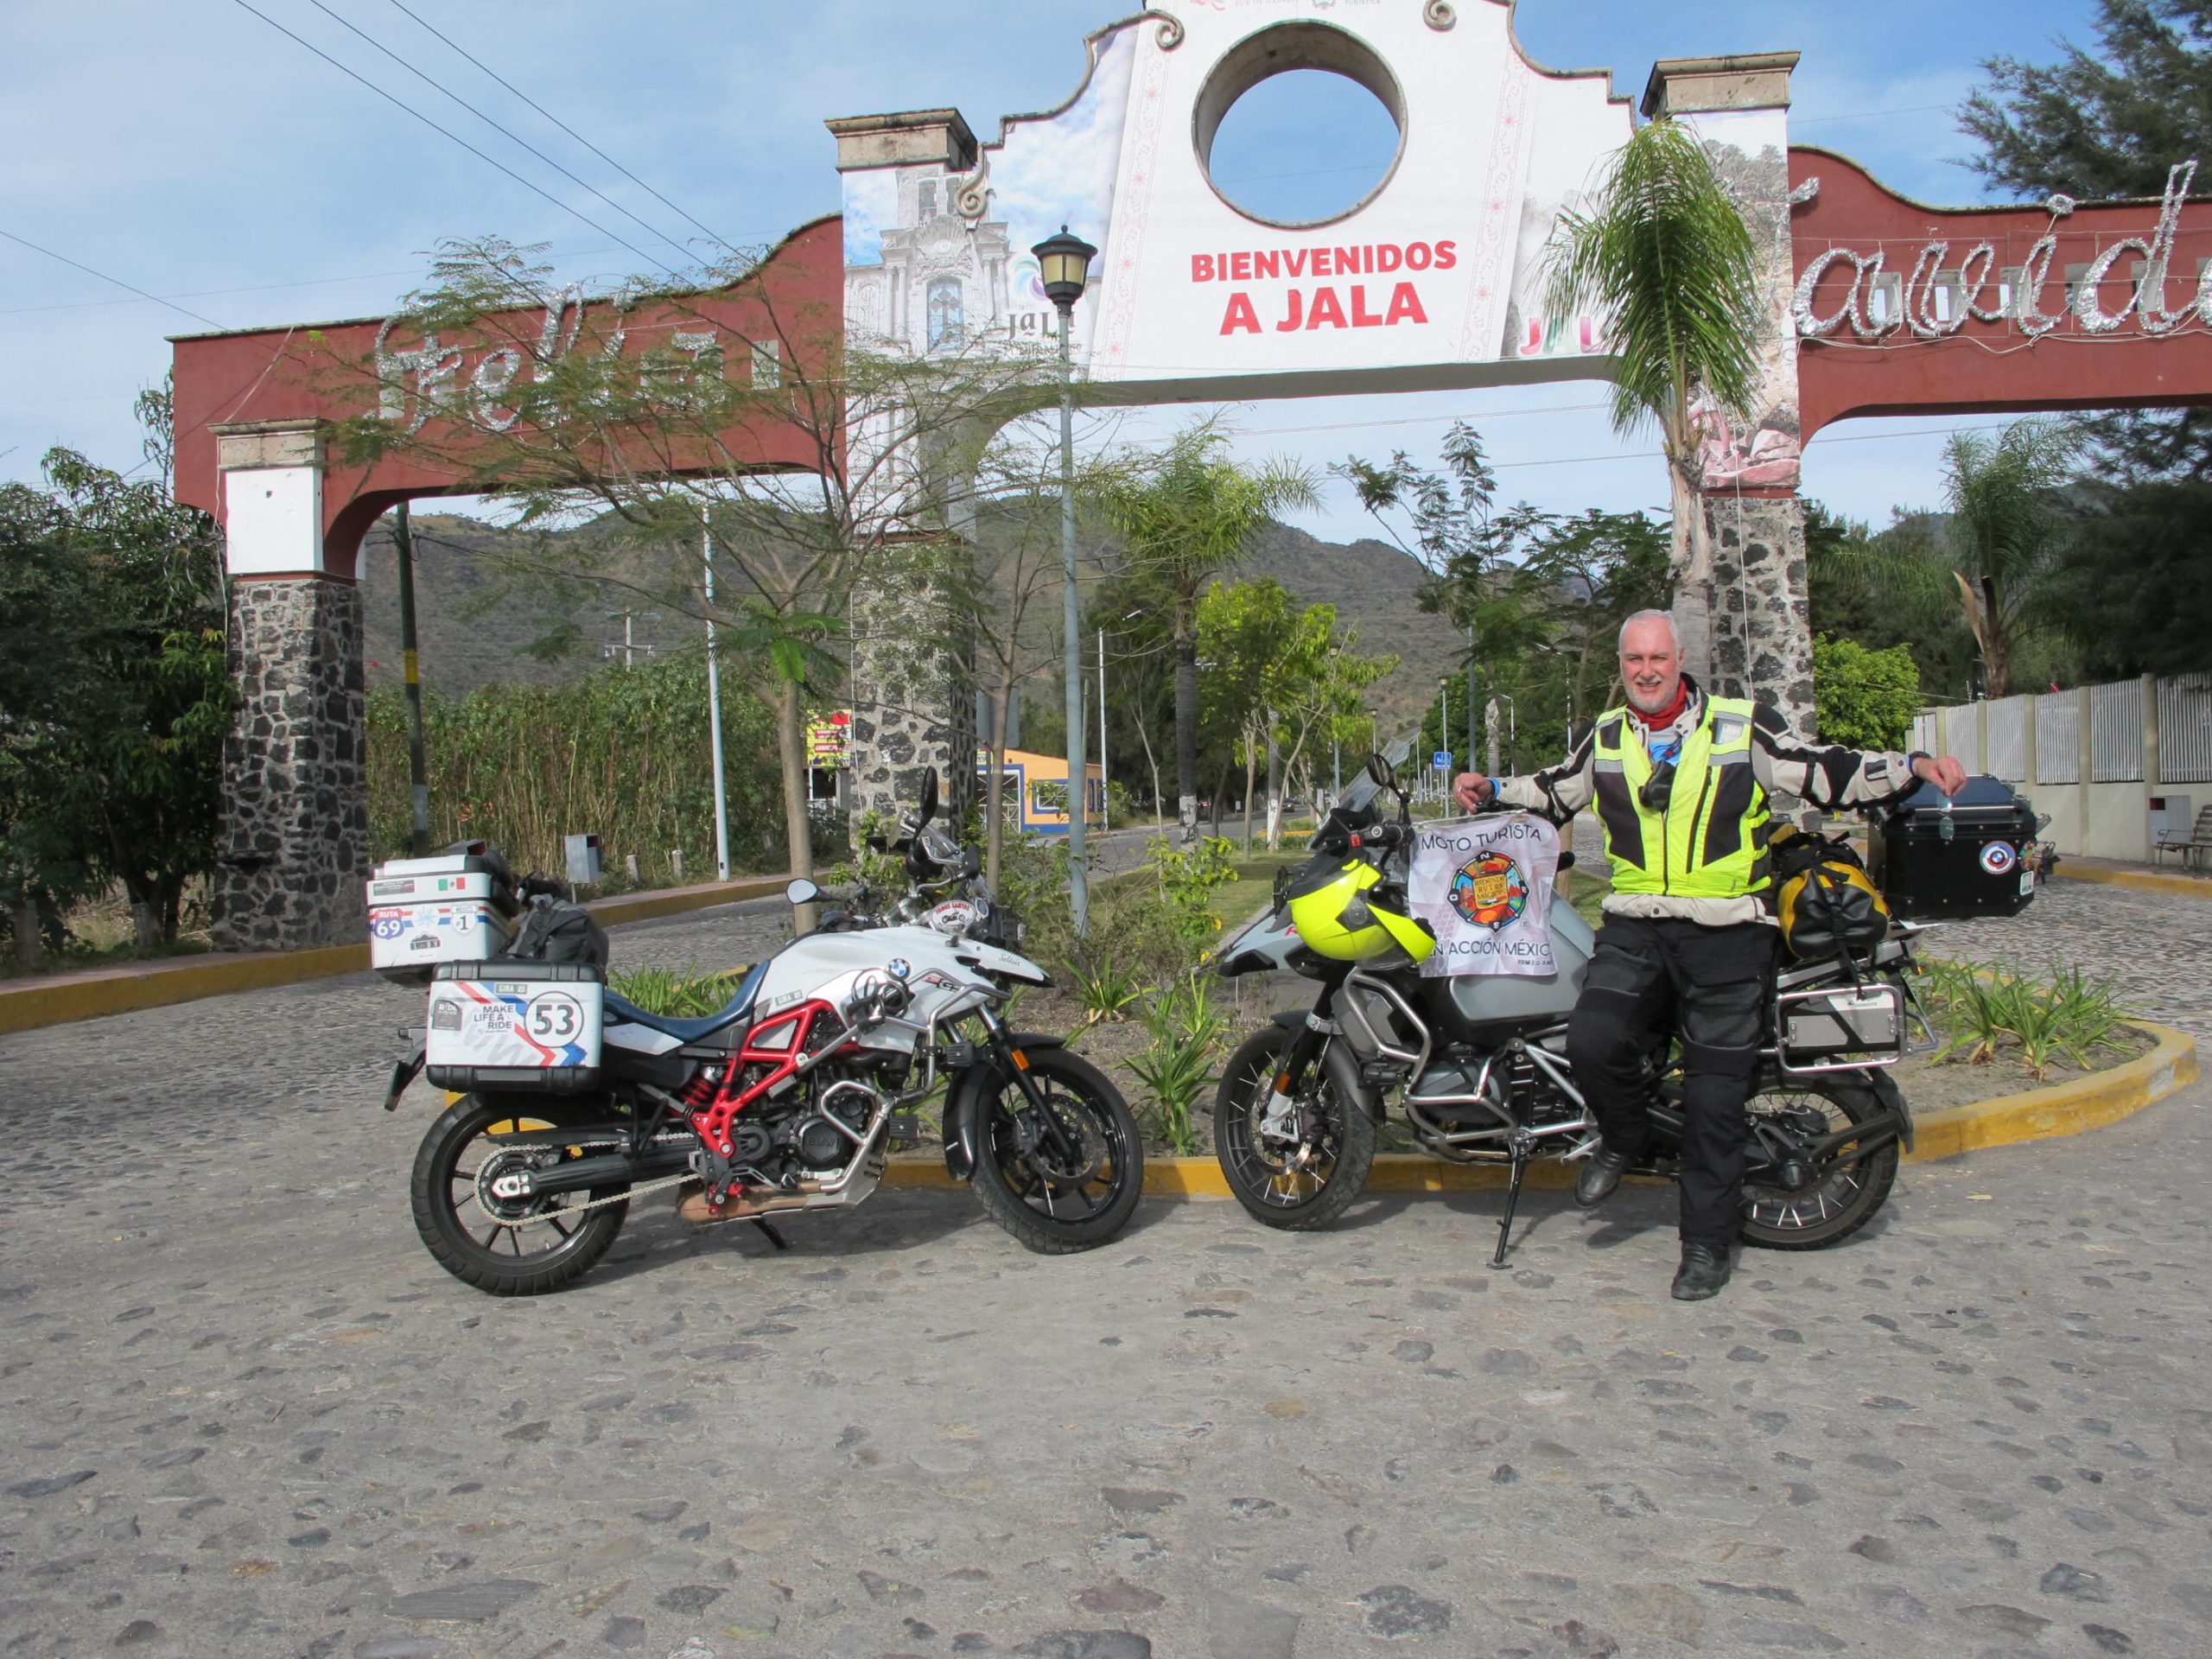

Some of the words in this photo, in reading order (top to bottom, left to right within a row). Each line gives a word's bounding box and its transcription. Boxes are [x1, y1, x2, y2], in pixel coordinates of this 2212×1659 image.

[1192, 240, 1457, 283] BIENVENIDOS
[1219, 292, 1262, 335] A
[1275, 282, 1428, 333] JALA
[1520, 316, 1624, 354] JAL
[1421, 834, 1471, 853] MOTO
[1476, 823, 1541, 848] TURISTA
[378, 911, 398, 919] RUTA
[377, 920, 401, 937] 69
[1429, 944, 1444, 957] N
[1448, 938, 1501, 955] ACCIÓN
[1504, 939, 1551, 957] MÉXIC
[474, 1014, 496, 1022] LIFE
[497, 1013, 505, 1021] A
[483, 1005, 514, 1014] MAKE
[487, 1020, 512, 1029] RIDE
[533, 1004, 575, 1035] 53
